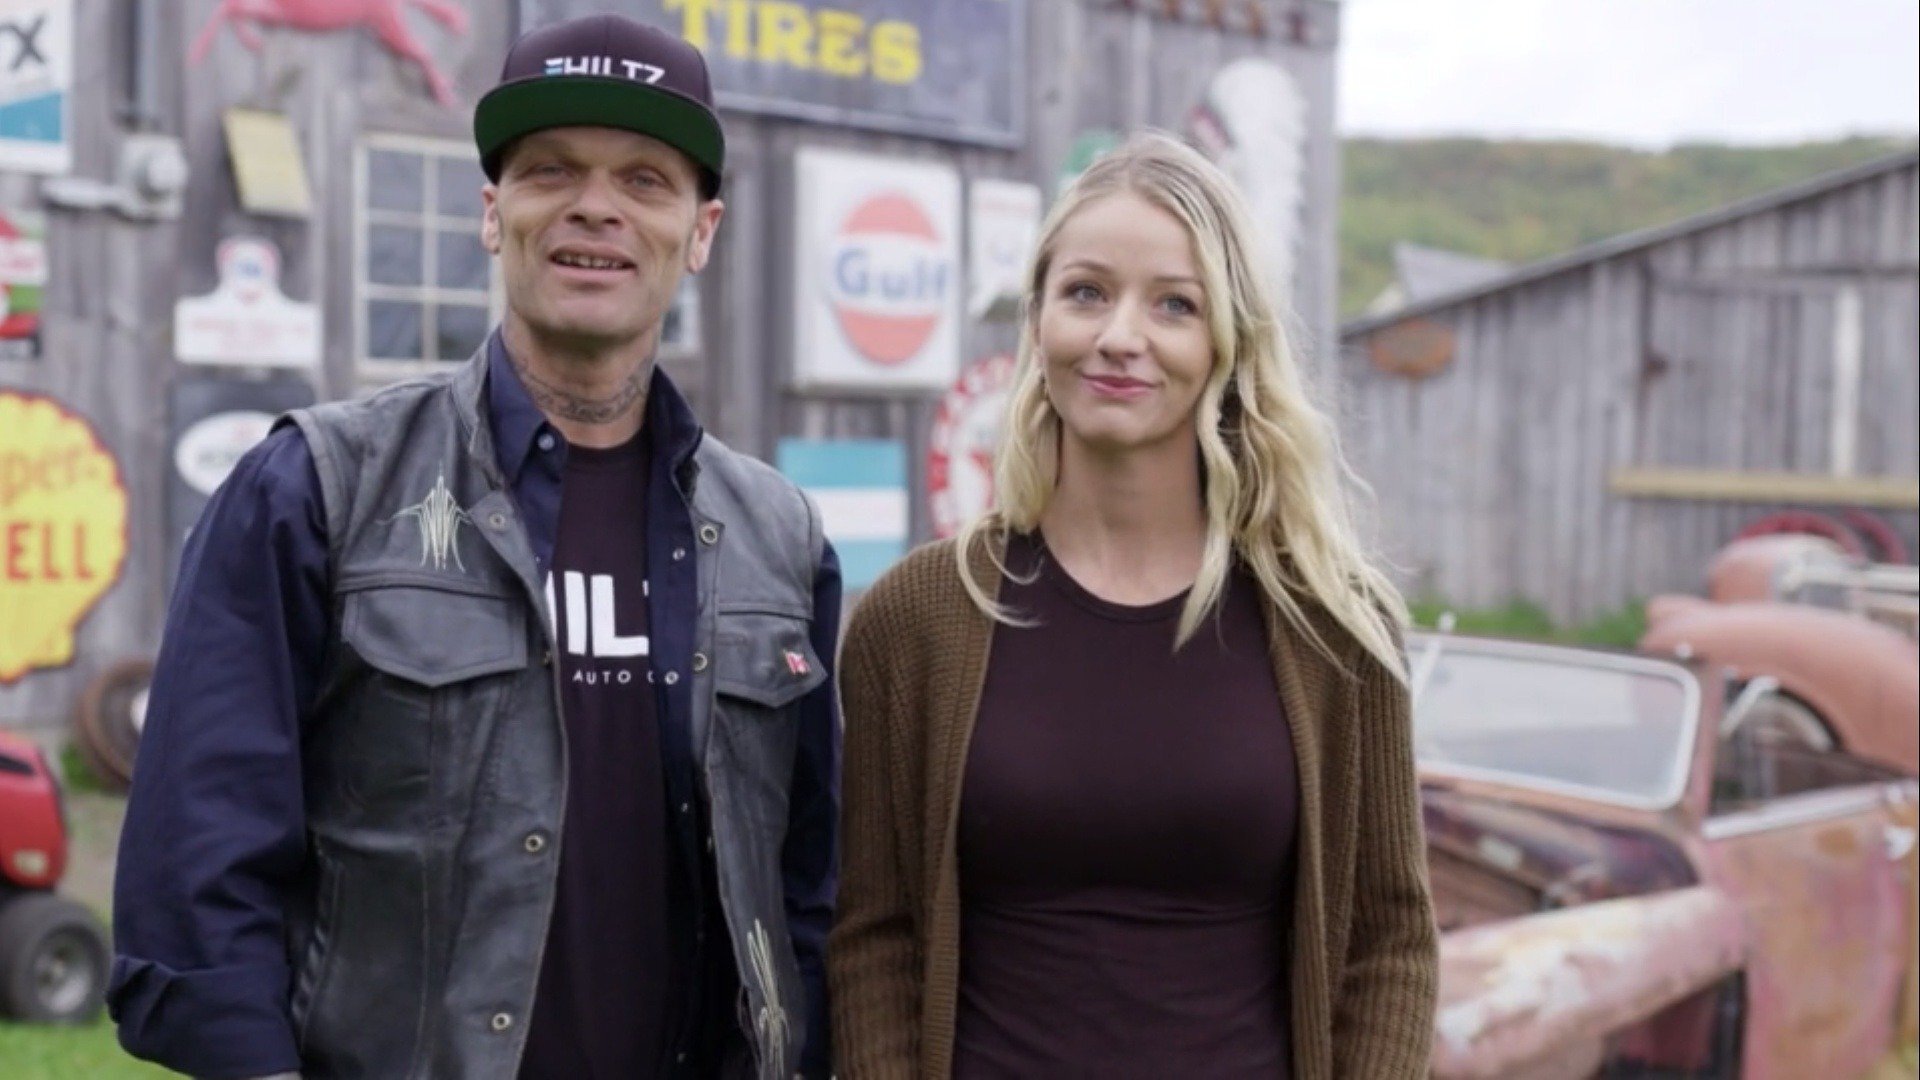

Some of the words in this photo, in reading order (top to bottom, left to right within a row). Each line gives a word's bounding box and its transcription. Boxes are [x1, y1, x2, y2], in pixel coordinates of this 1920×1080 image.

[662, 0, 920, 85] TIRES
[835, 247, 949, 300] Gulf
[572, 669, 631, 685] AUTO
